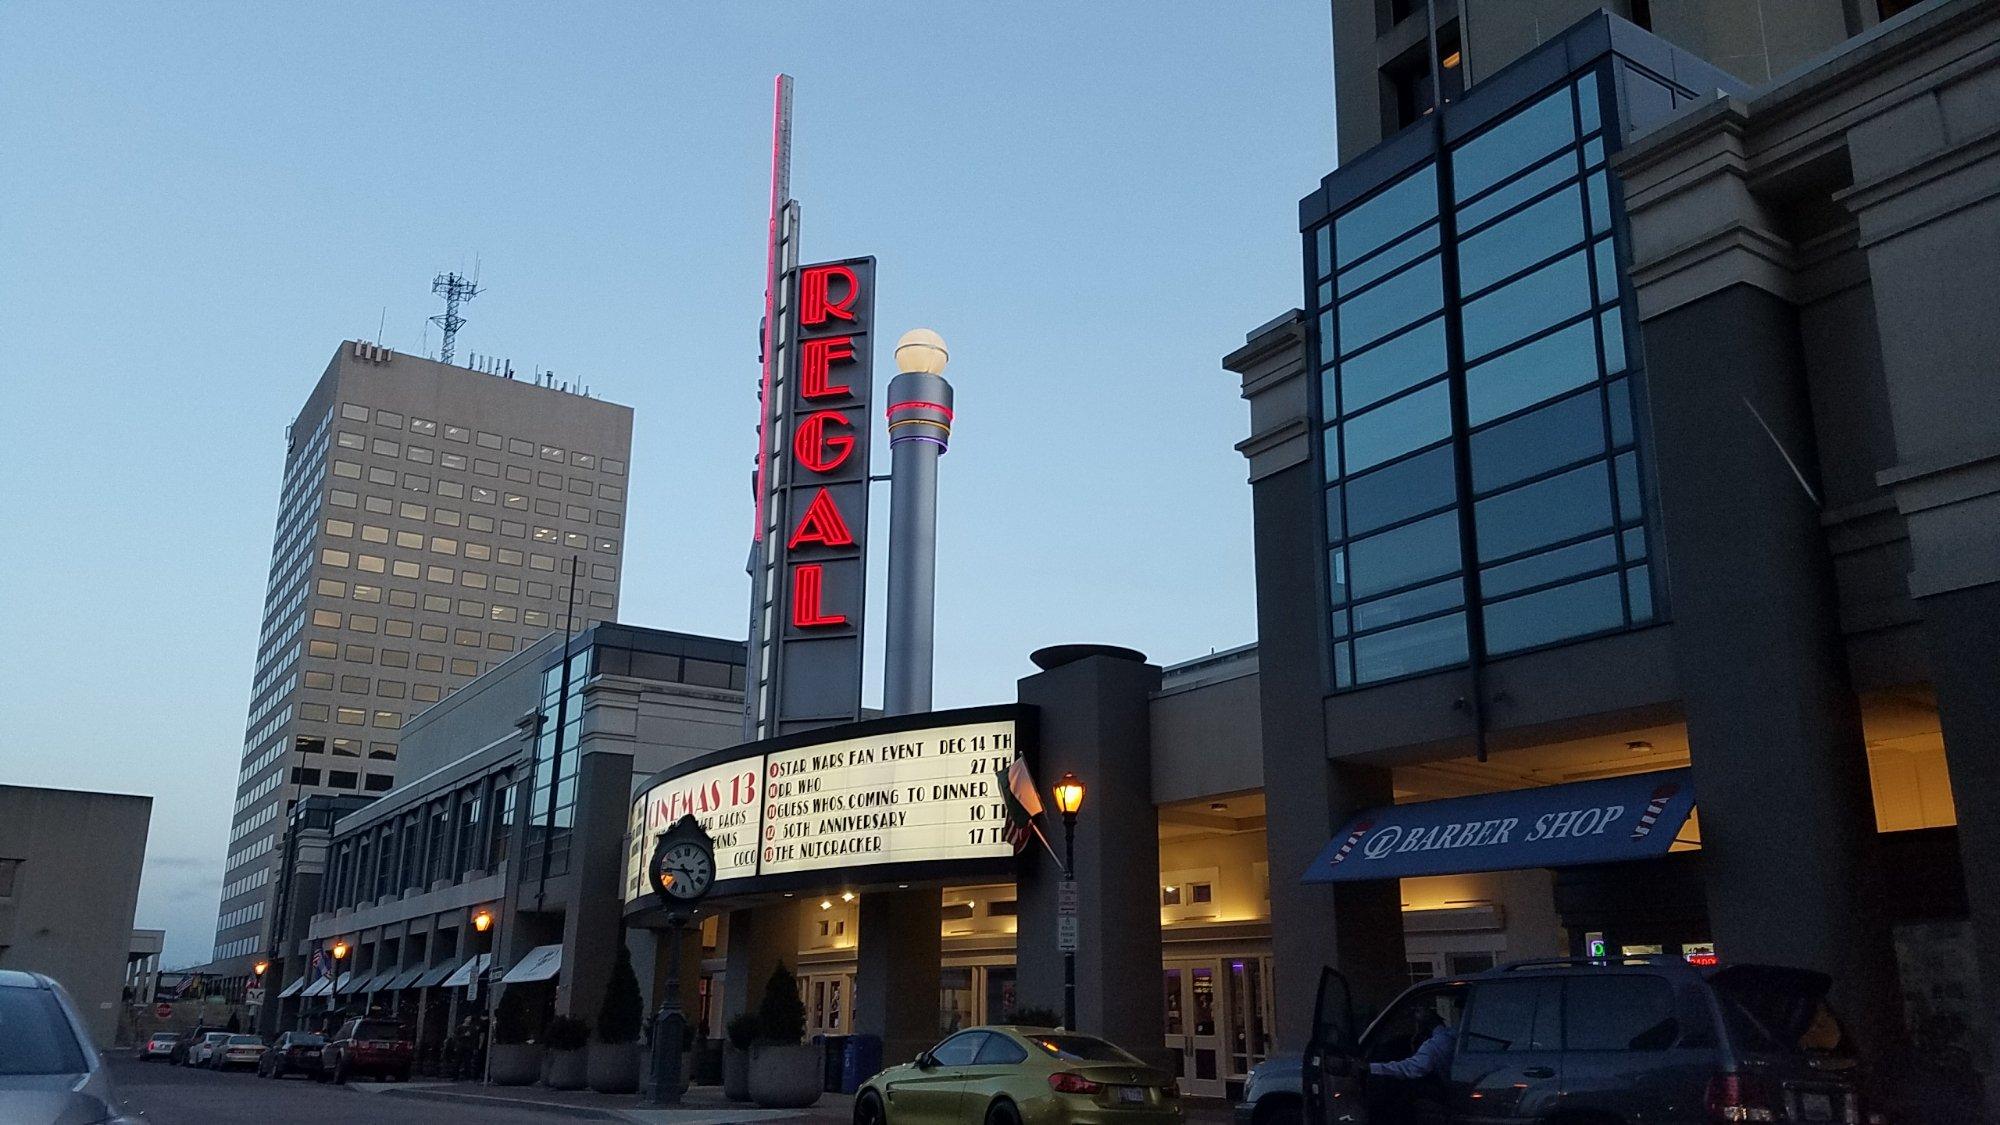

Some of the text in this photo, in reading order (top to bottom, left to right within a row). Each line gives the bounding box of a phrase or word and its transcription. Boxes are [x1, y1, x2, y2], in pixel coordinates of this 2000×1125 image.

[788, 266, 862, 627] REGAL
[779, 759, 807, 777] STAR
[812, 752, 844, 771] WARS
[849, 748, 875, 766] FAN
[881, 742, 925, 762] EVENT
[940, 737, 967, 755] DEC
[971, 736, 986, 752] 14
[992, 733, 1012, 750] TH
[778, 781, 792, 798] DR
[798, 777, 822, 794] WHO
[970, 758, 987, 775] 27
[991, 754, 1012, 773] TH
[647, 771, 756, 831] CINEMAS 13
[719, 810, 747, 828] PACKS
[777, 800, 809, 818] GUESS
[813, 795, 844, 812] WHOS
[848, 788, 899, 809] COMING
[907, 786, 926, 803] TO
[933, 781, 989, 800] DINNER
[782, 821, 811, 839] 50TH
[819, 810, 907, 835] ANNIVERSARY
[969, 804, 986, 821] 10
[1396, 817, 1519, 853] BARBER
[1524, 805, 1625, 842] SHOP
[733, 849, 757, 867] COCO
[775, 844, 795, 860] THE
[800, 835, 882, 859] NUTCRACKER
[968, 828, 984, 845] 17
